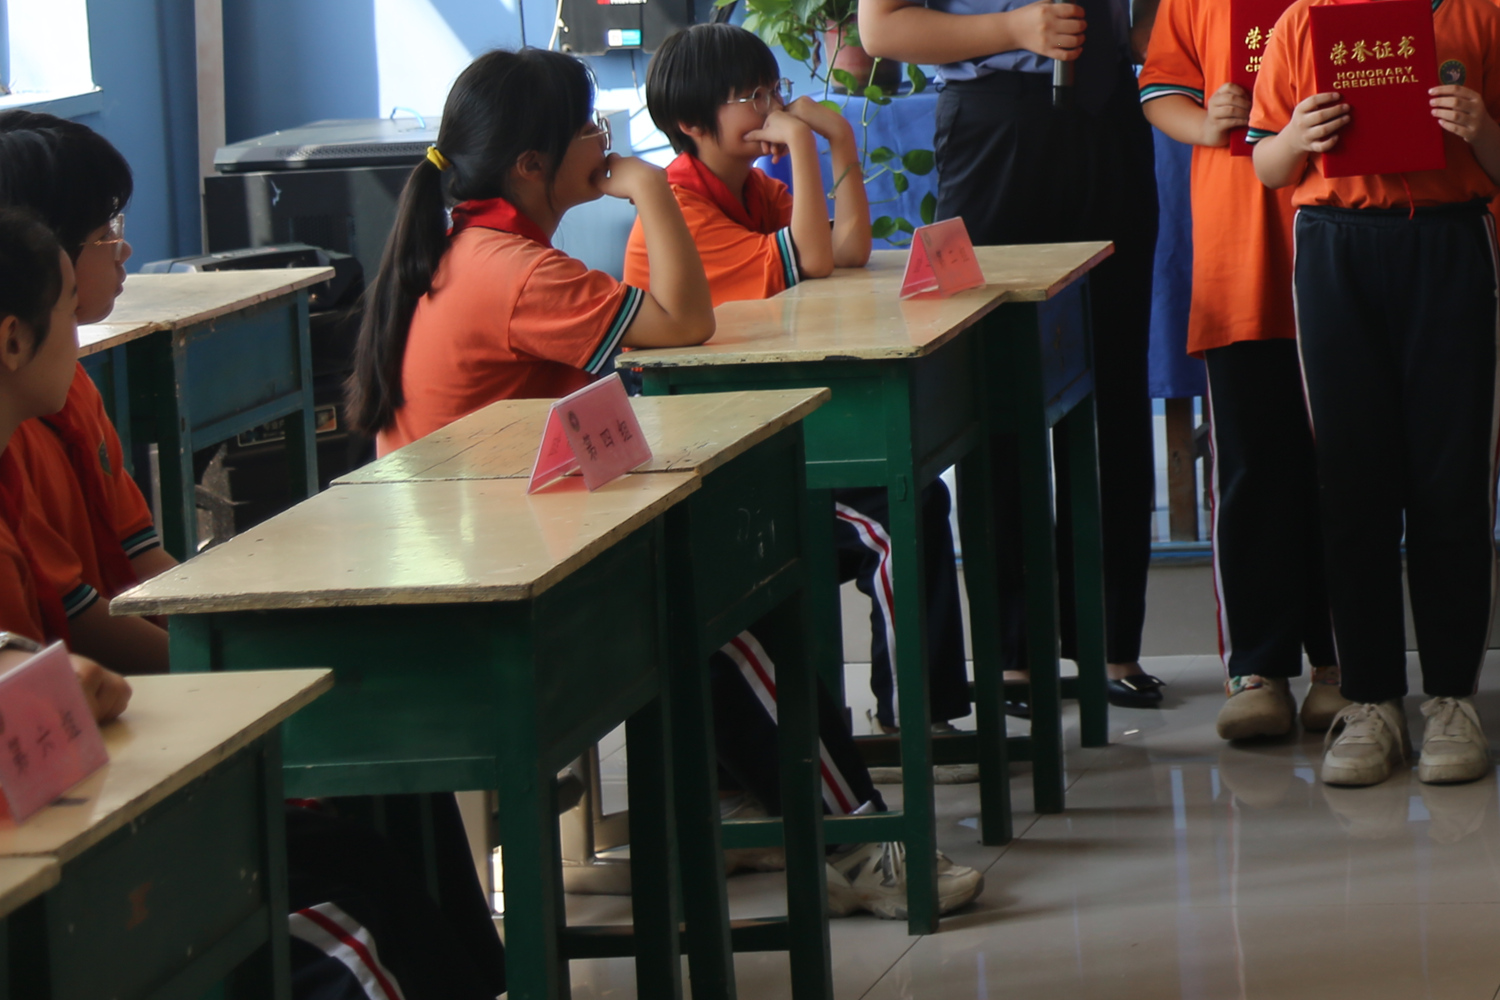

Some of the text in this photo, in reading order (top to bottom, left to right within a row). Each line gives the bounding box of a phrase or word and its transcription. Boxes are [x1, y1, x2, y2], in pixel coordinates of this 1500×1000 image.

[1329, 35, 1415, 66] 荣誉证书
[1336, 66, 1413, 81] HONORARY
[1332, 74, 1419, 90] CREDENTIAL
